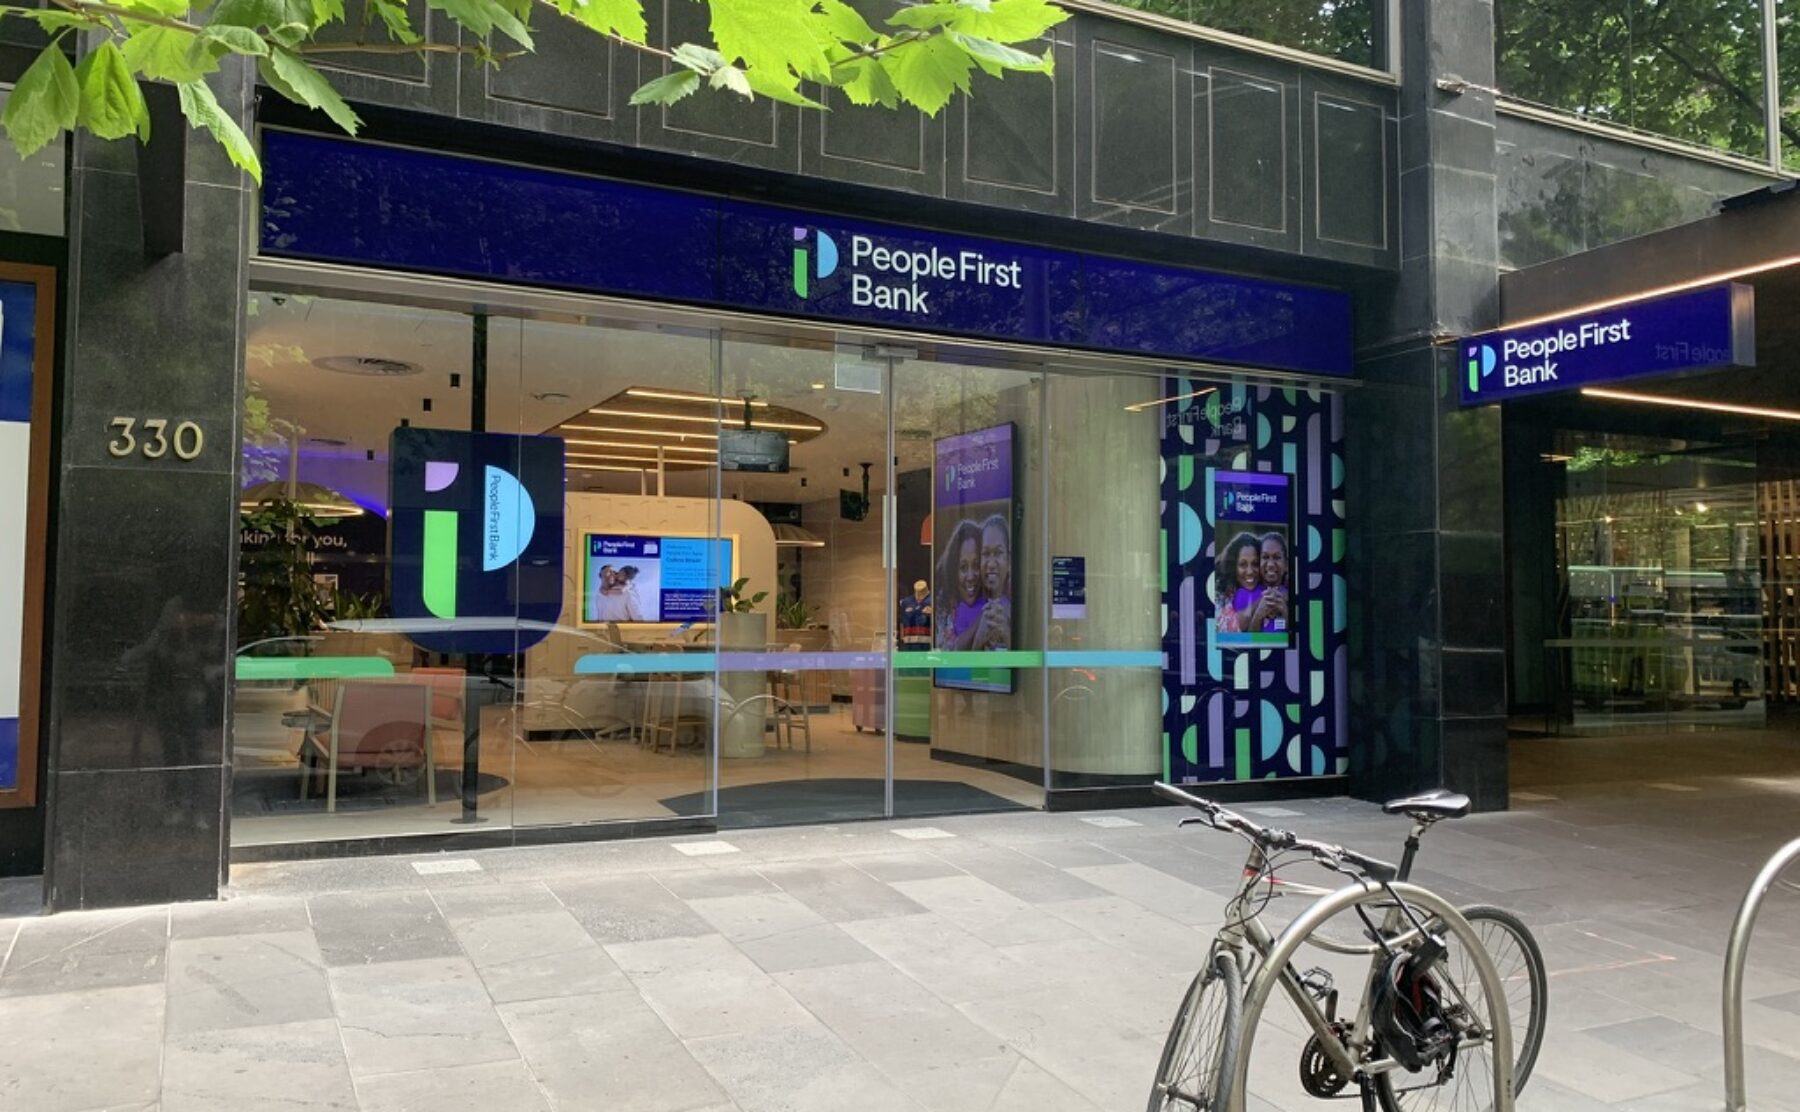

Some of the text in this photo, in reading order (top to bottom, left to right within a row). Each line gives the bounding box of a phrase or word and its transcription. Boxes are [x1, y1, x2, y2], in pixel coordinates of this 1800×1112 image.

[852, 273, 929, 314] Bank
[1504, 360, 1558, 388] Bank
[109, 416, 204, 460] 330
[313, 533, 348, 549] you,
[489, 535, 501, 561] Bank
